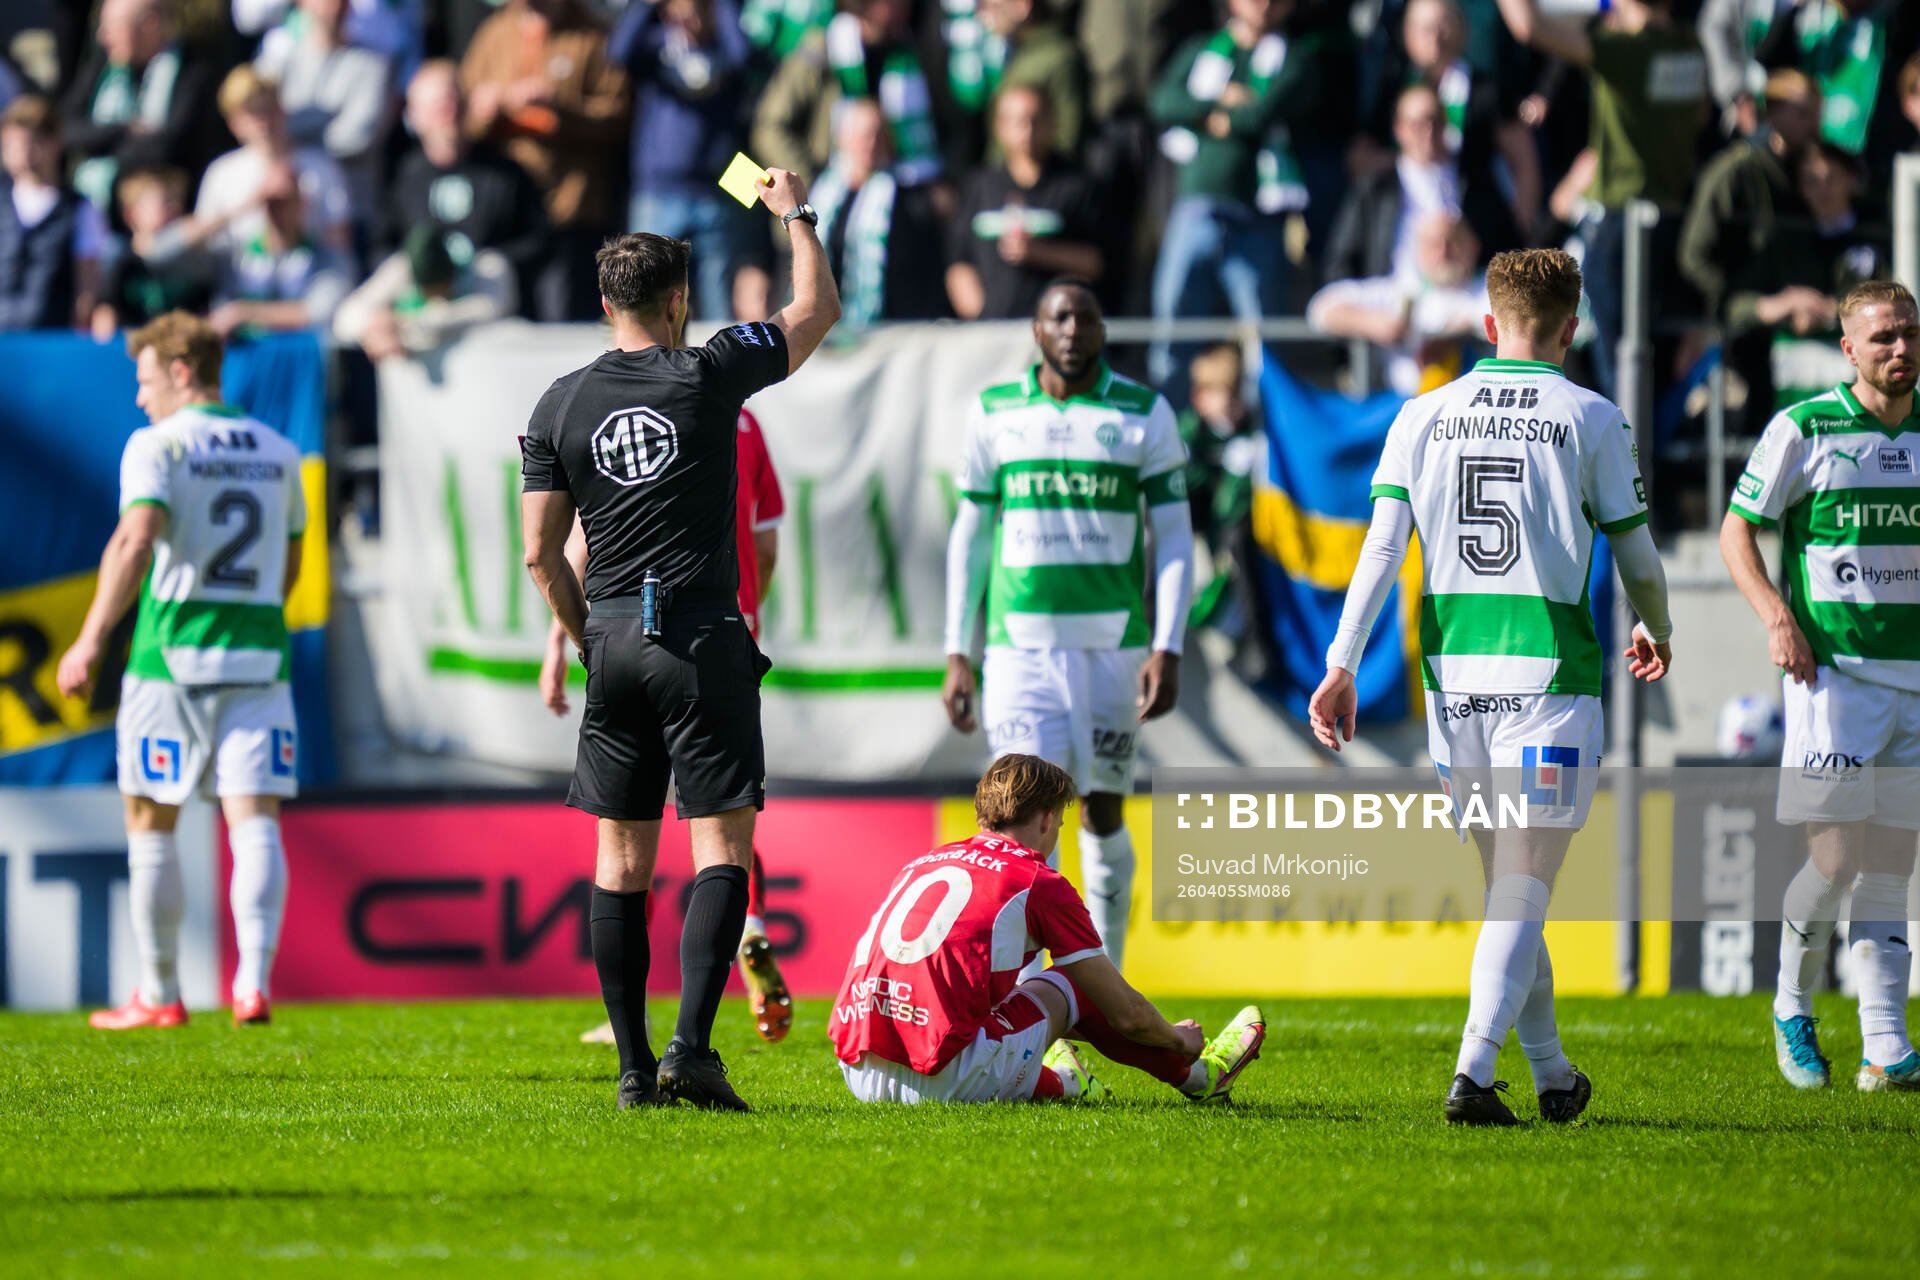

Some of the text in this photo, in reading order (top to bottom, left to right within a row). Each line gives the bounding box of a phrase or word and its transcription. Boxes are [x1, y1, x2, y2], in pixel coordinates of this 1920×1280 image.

[1469, 387, 1539, 409] ABB
[599, 414, 670, 478] MG
[1433, 415, 1569, 448] GUNNARSSON
[1898, 450, 1908, 461] &
[1005, 471, 1119, 498] HITACHI
[1459, 456, 1524, 576] 5
[203, 489, 262, 590] 2
[1803, 751, 1864, 775] RYDS
[853, 866, 973, 969] 10
[1129, 890, 1472, 937] ORKWEA
[851, 977, 913, 1002] NRDIC
